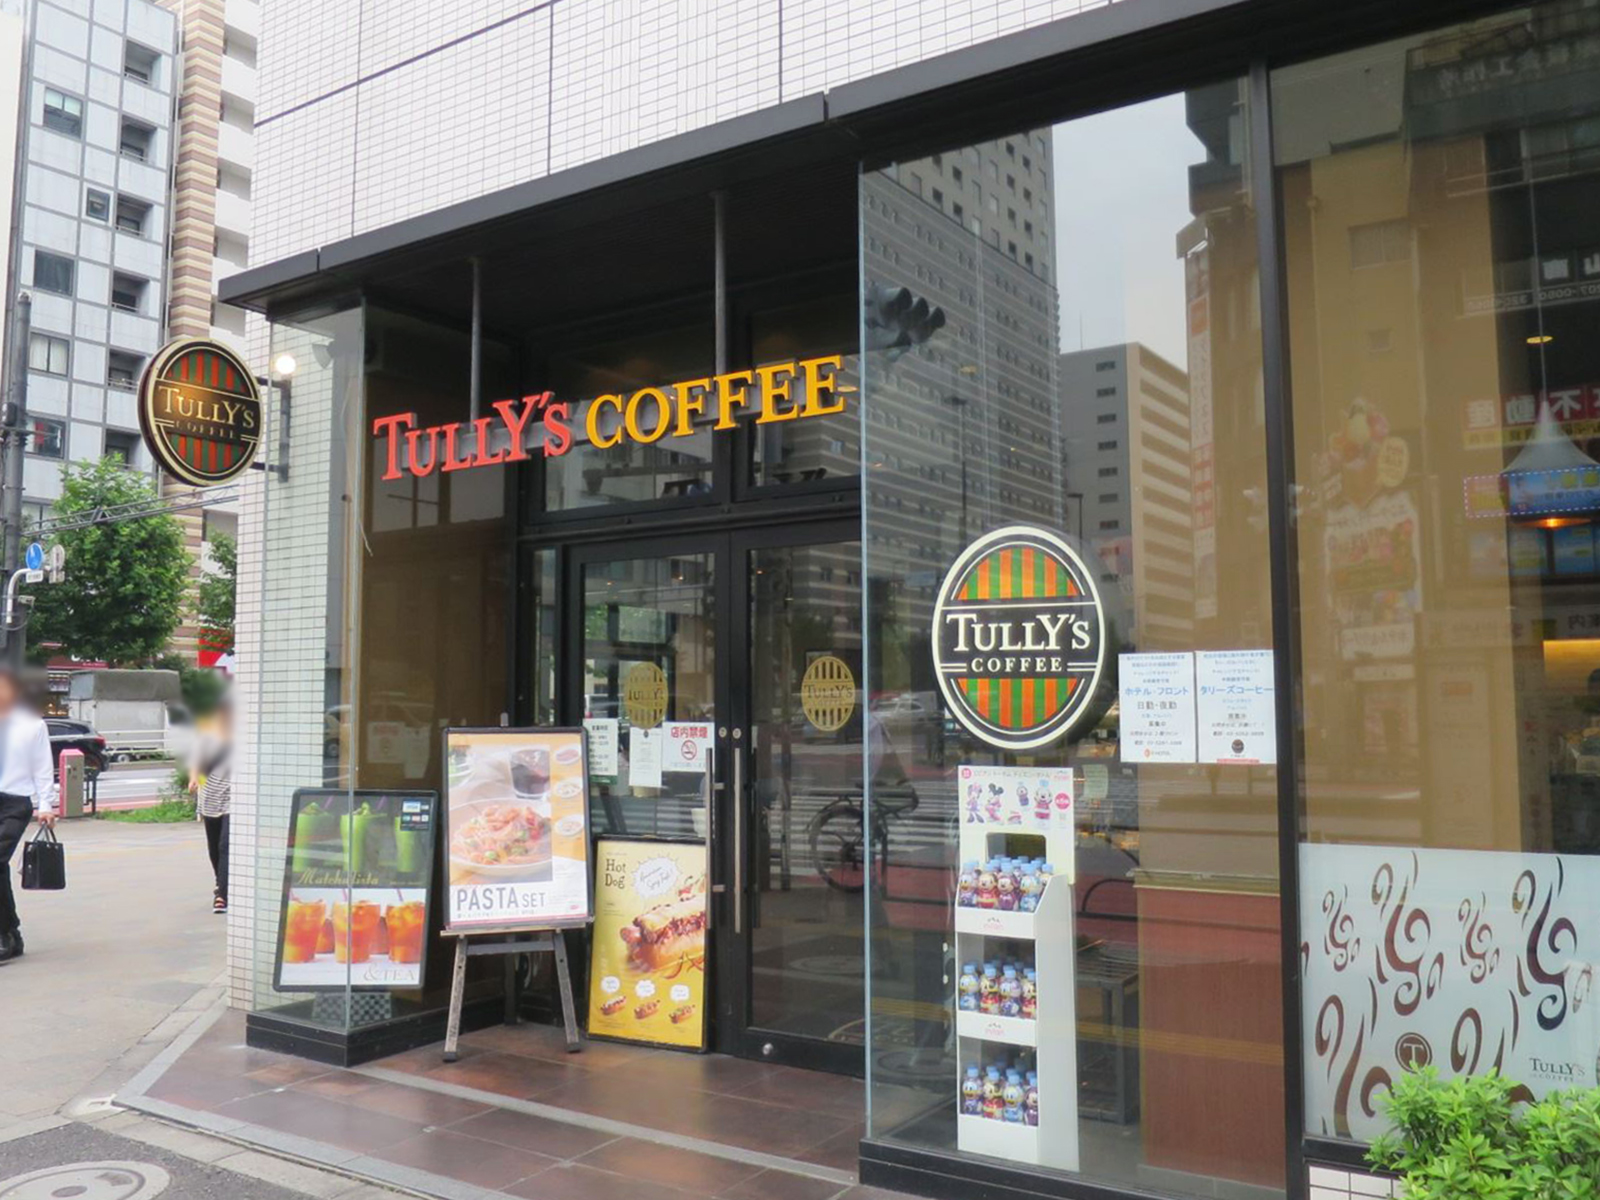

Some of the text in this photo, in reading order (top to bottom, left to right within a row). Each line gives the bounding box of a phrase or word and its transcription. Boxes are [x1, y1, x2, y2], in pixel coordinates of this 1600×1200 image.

[158, 385, 255, 430] TULLY'S
[373, 354, 845, 481] TULLY'S COFFEE
[946, 613, 1092, 651] TULLY'S
[970, 657, 1063, 673] COFFEE
[1200, 685, 1274, 695] タリーズコーヒー
[671, 726, 708, 738] 店内禁煙
[606, 858, 626, 873] Hot
[605, 873, 625, 889] Dog
[457, 887, 546, 911] PASTA SET
[1403, 1044, 1423, 1062] T
[1529, 1057, 1586, 1077] TULLY'S
